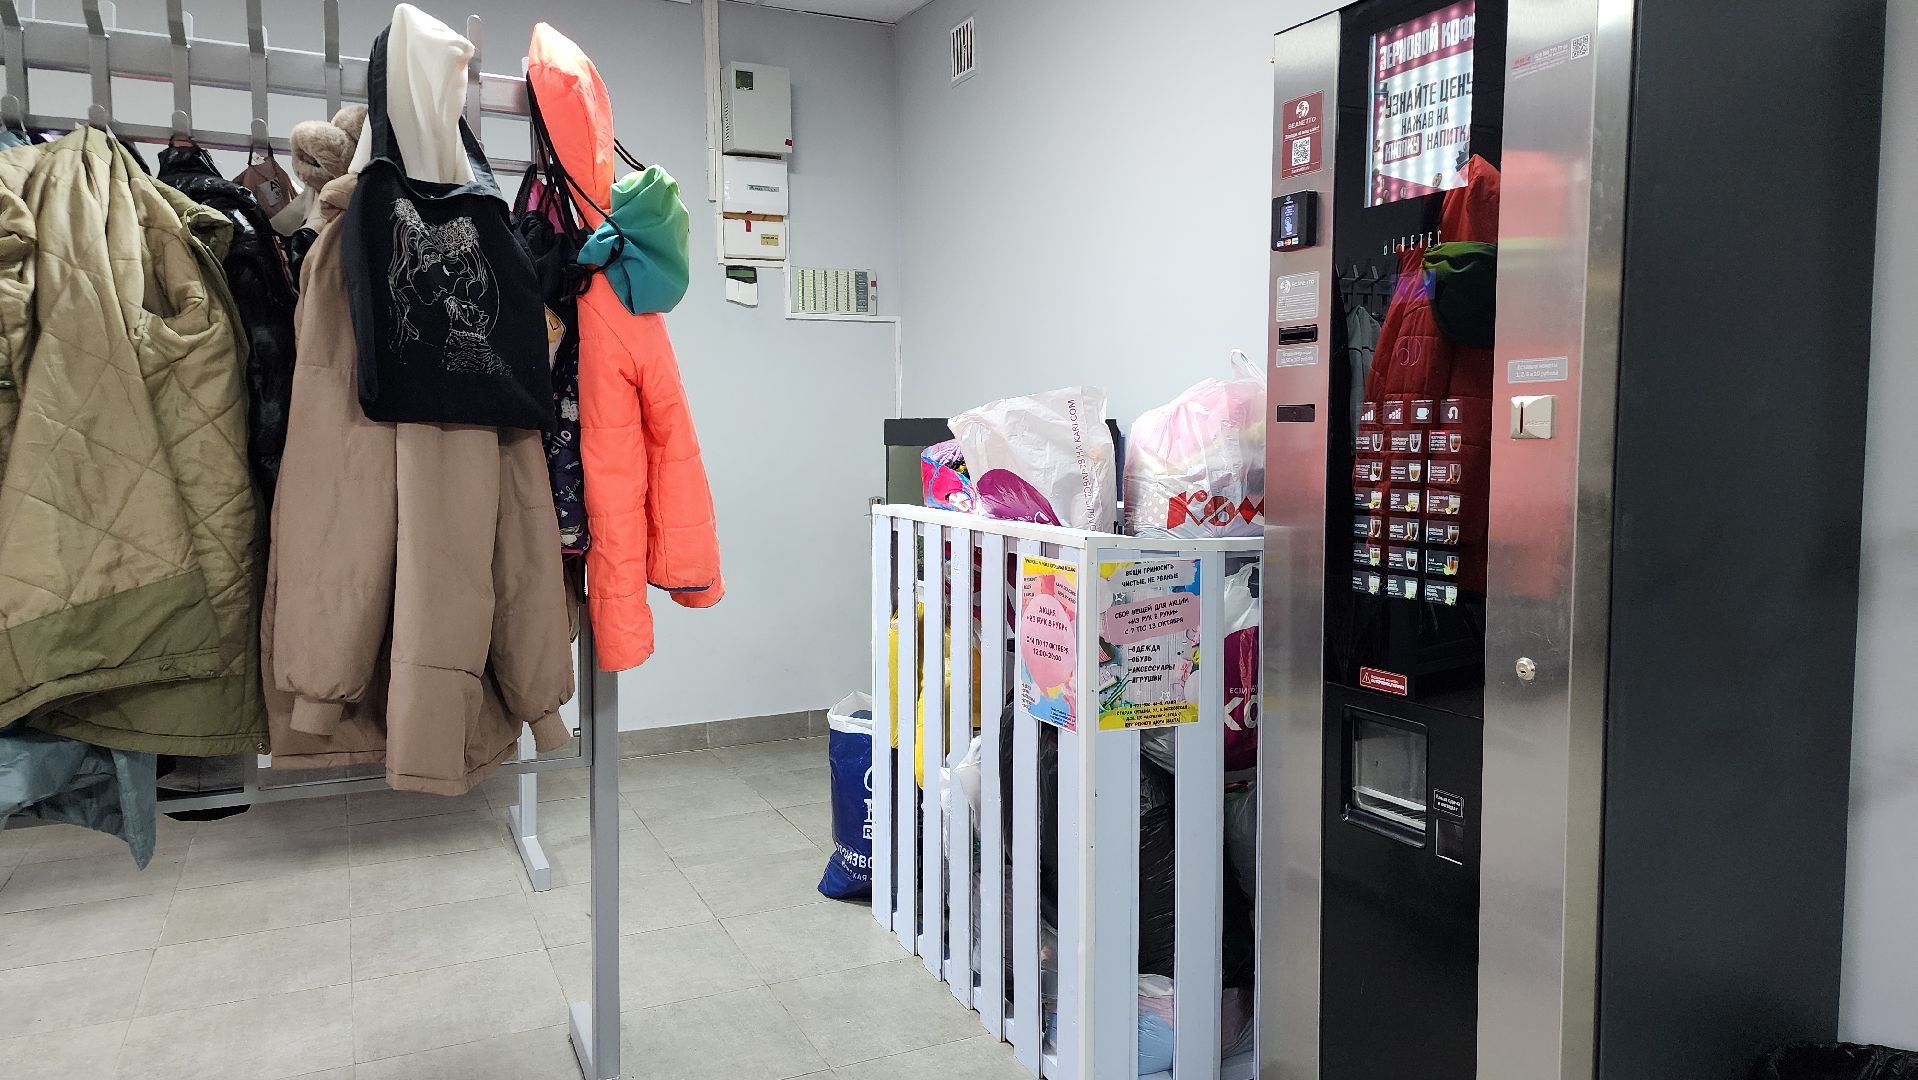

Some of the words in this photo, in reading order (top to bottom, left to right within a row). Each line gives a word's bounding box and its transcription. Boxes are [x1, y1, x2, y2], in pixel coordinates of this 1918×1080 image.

[1380, 22, 1439, 71] ЗЕРНОВОЙ
[1385, 81, 1437, 118] УЗНАЙТЕ
[1287, 117, 1316, 129] BEANETTO
[1401, 110, 1434, 135] НАЖАВ
[1437, 106, 1449, 125] НА
[1114, 610, 1130, 619] СБОР
[1132, 603, 1153, 615] ВЕЩЕЙ
[1154, 602, 1167, 611] ДЛЯ
[1141, 614, 1152, 623] РУК
[1136, 624, 1147, 633] ПО
[1149, 622, 1156, 630] 13
[1157, 616, 1184, 628] ОКТЯБРЯ
